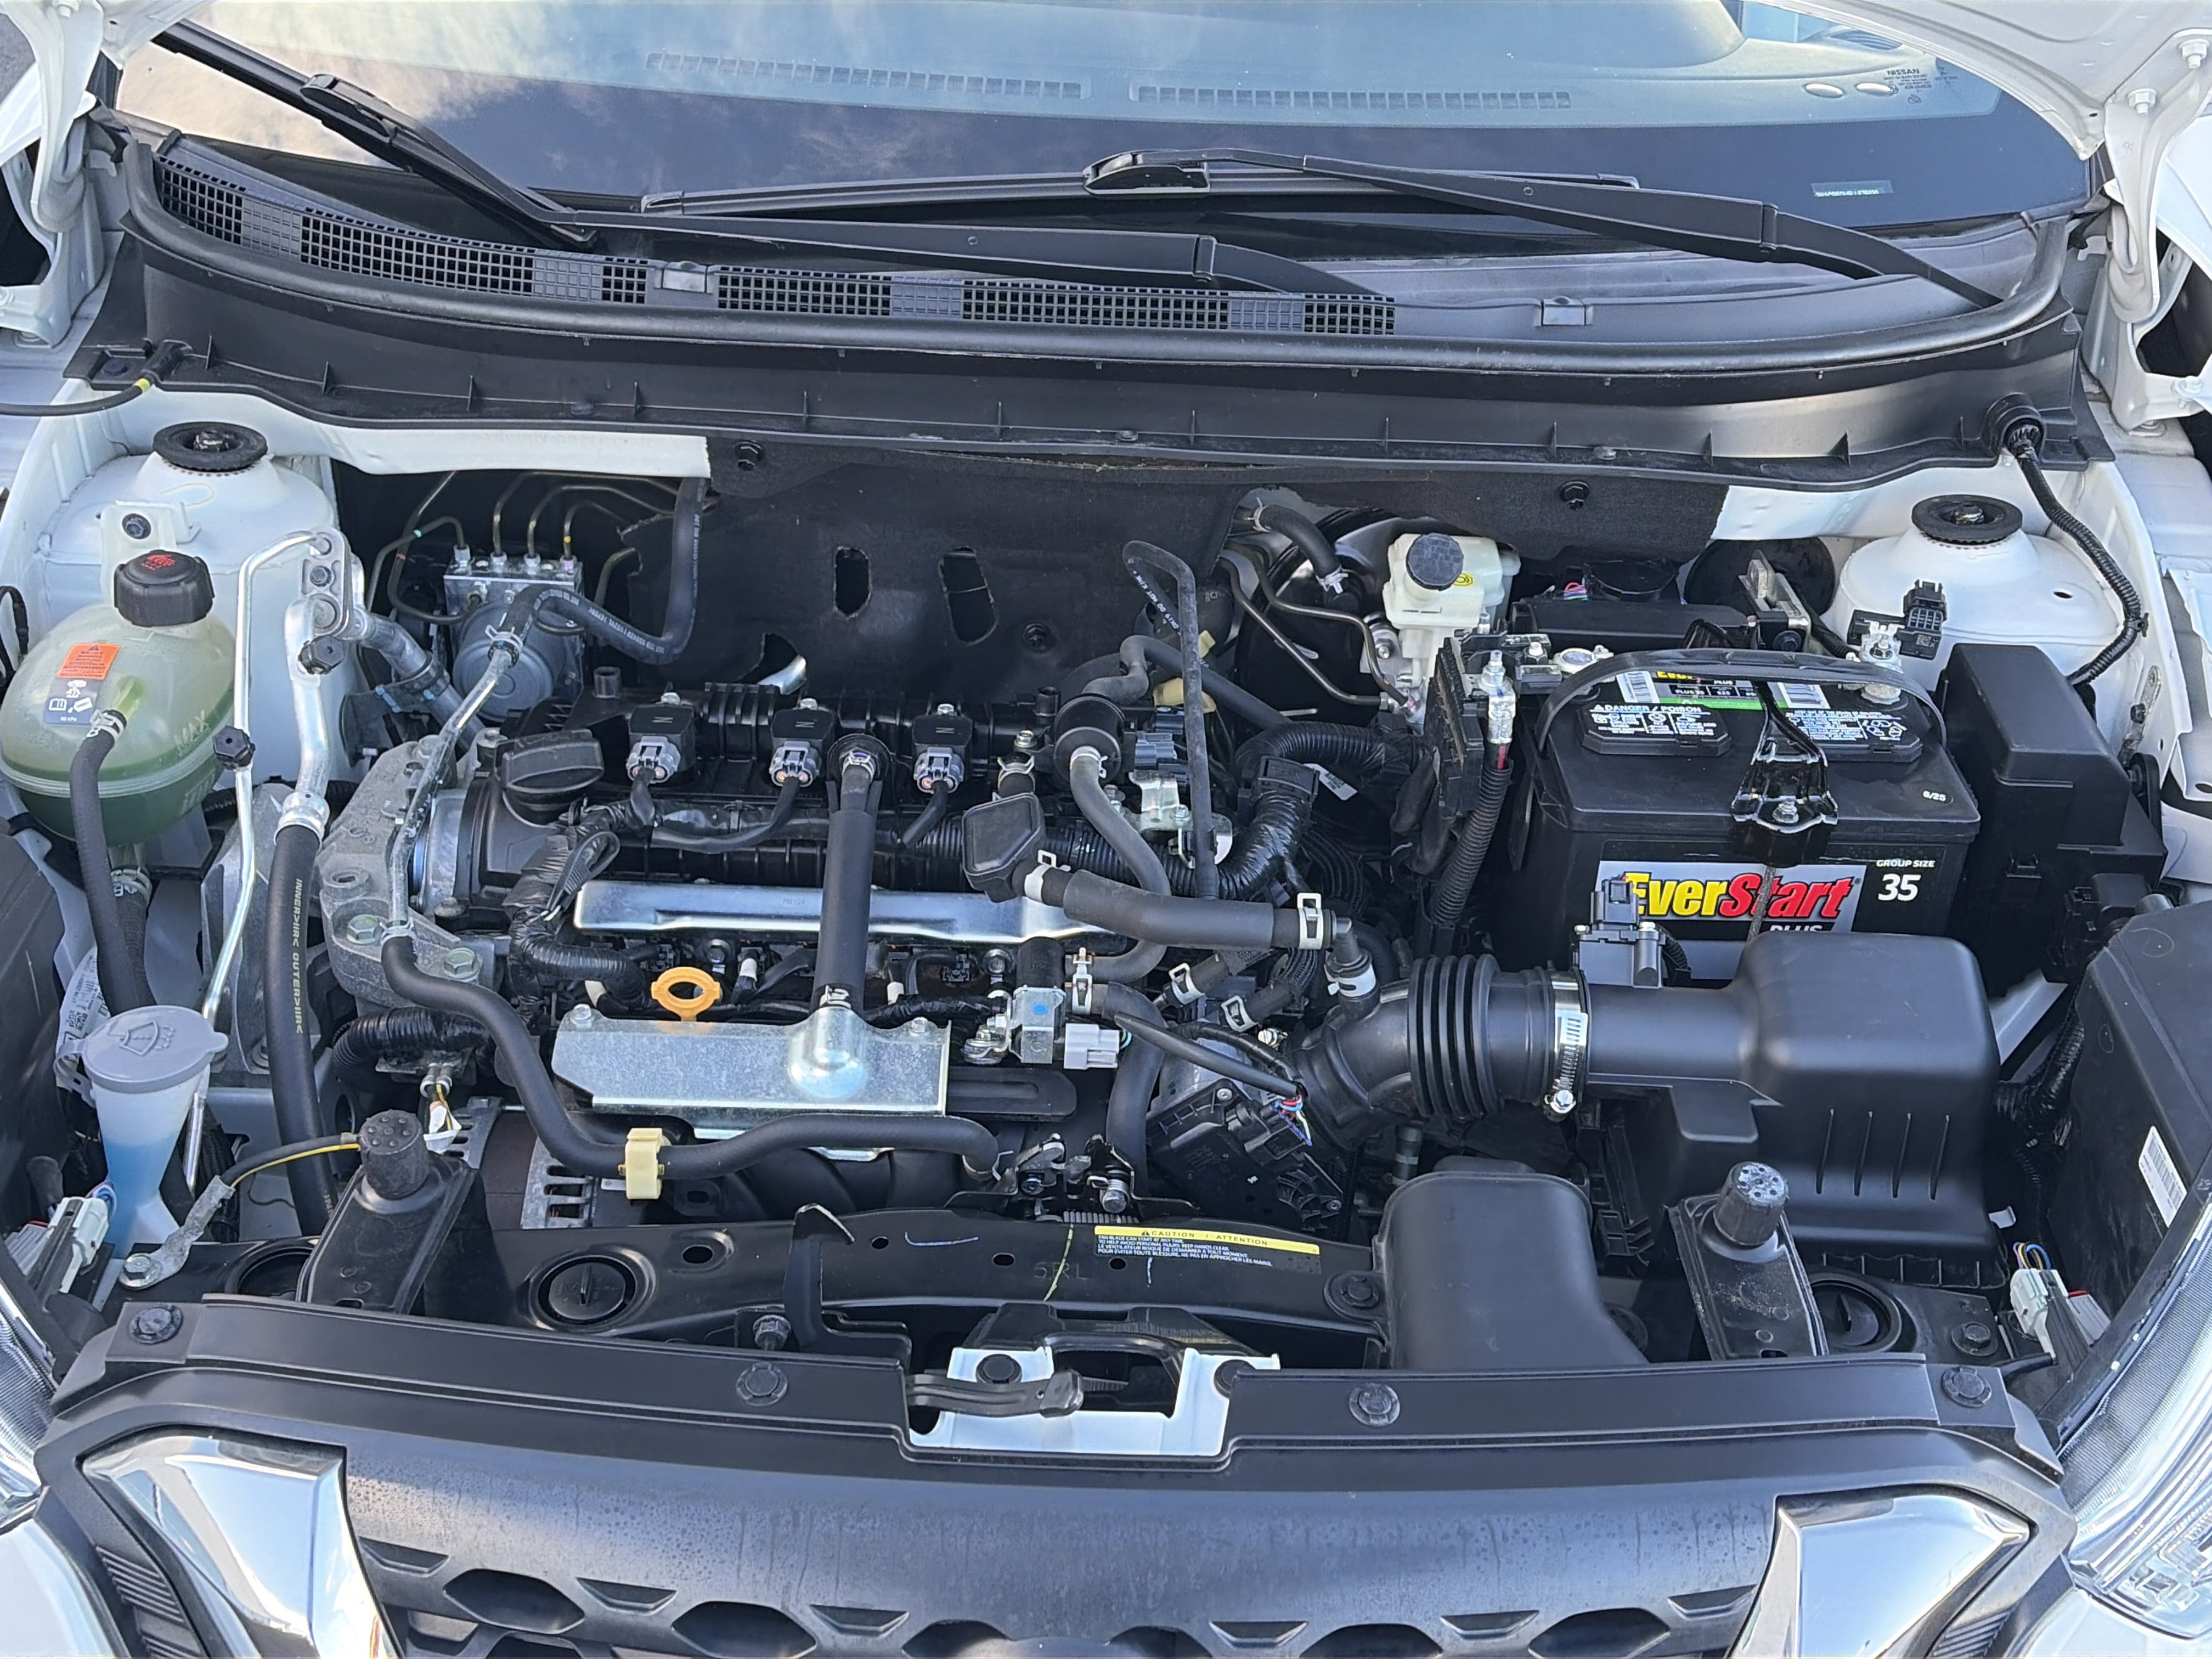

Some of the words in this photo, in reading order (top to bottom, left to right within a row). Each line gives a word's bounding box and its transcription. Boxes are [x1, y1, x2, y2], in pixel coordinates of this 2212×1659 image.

[1146, 591, 1159, 602] NOT
[173, 710, 211, 758] MAX
[1923, 791, 1946, 802] 6/25
[1876, 859, 1912, 867] GROUP
[1878, 873, 1921, 901] 35
[1152, 1230, 1194, 1238] CAUTION
[1216, 1235, 1268, 1246] ATTENTION
